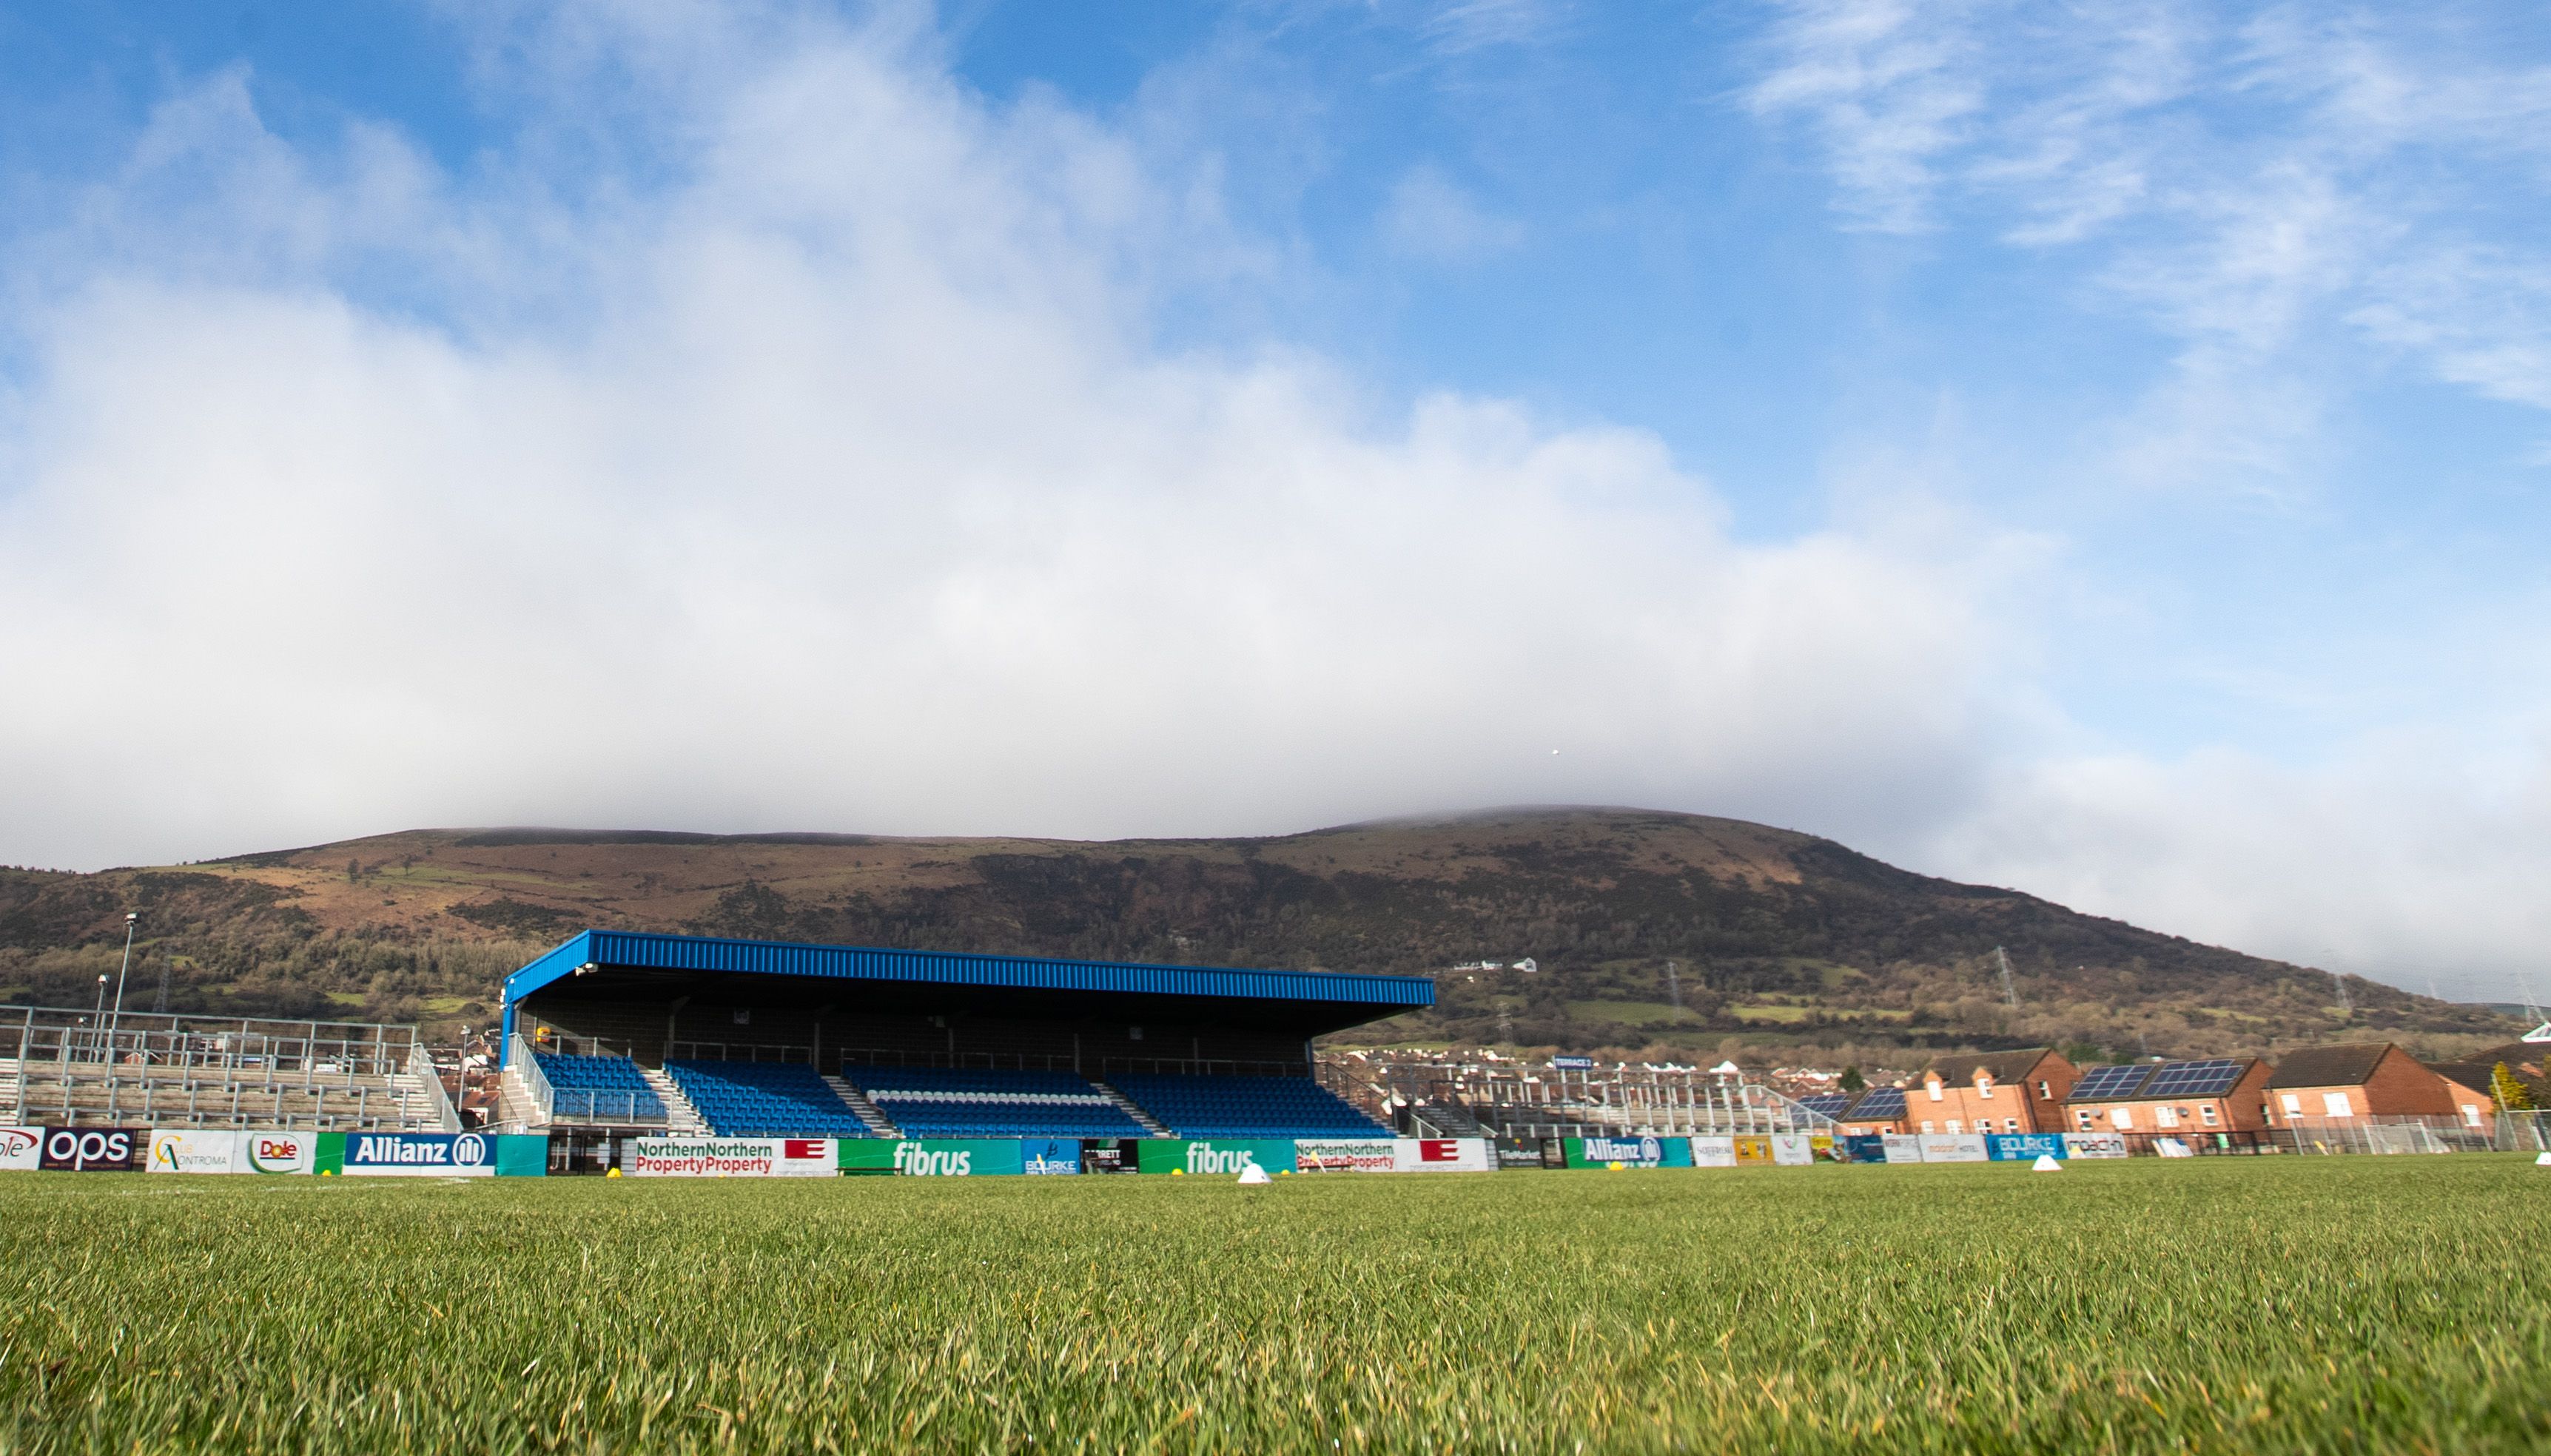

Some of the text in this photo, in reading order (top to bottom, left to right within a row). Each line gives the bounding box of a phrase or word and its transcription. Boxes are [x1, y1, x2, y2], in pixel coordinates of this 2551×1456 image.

[48, 1131, 130, 1170] ops
[261, 1140, 297, 1158] Dole
[355, 1136, 447, 1162] Allianz
[893, 1142, 971, 1176] fibrus
[1585, 1138, 1641, 1160] Allianz
